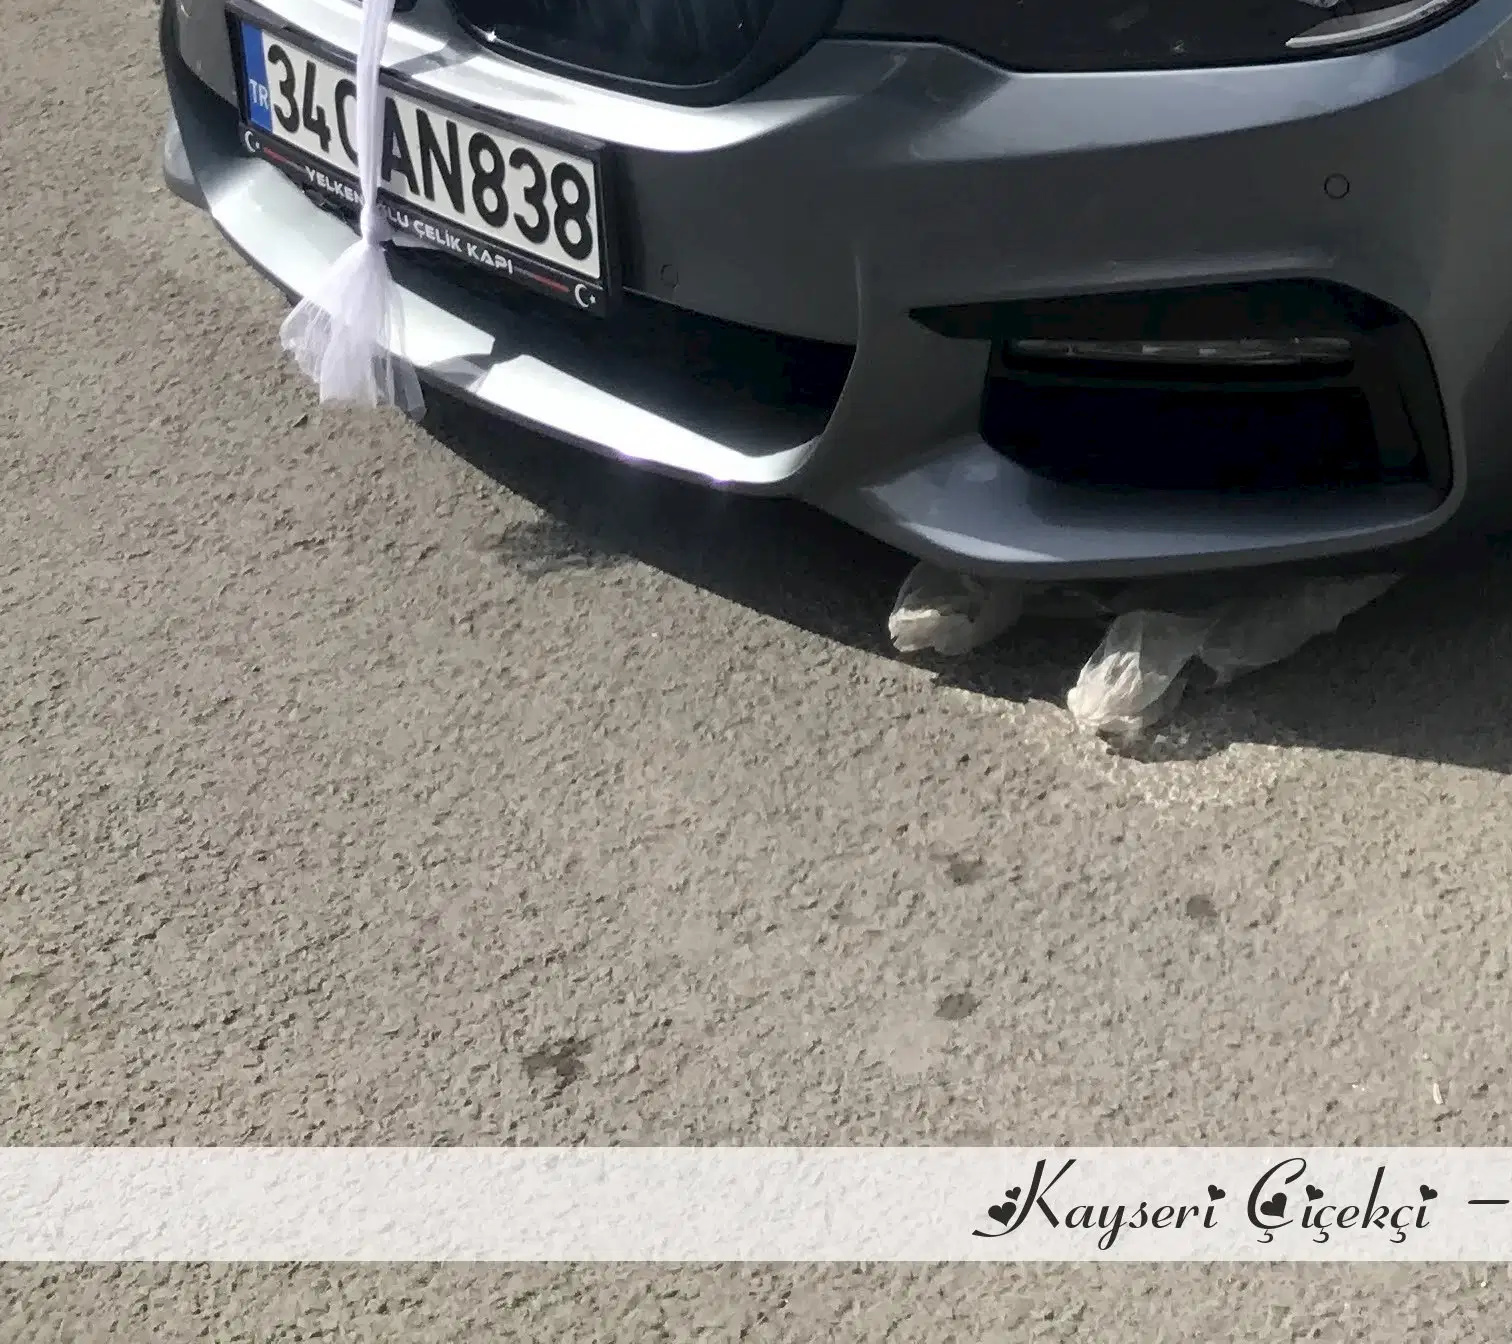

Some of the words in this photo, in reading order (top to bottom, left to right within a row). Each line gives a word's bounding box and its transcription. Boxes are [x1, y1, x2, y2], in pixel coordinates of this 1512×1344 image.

[249, 78, 269, 110] TR
[412, 219, 463, 254] ÇELİK
[466, 242, 514, 275] KAPI
